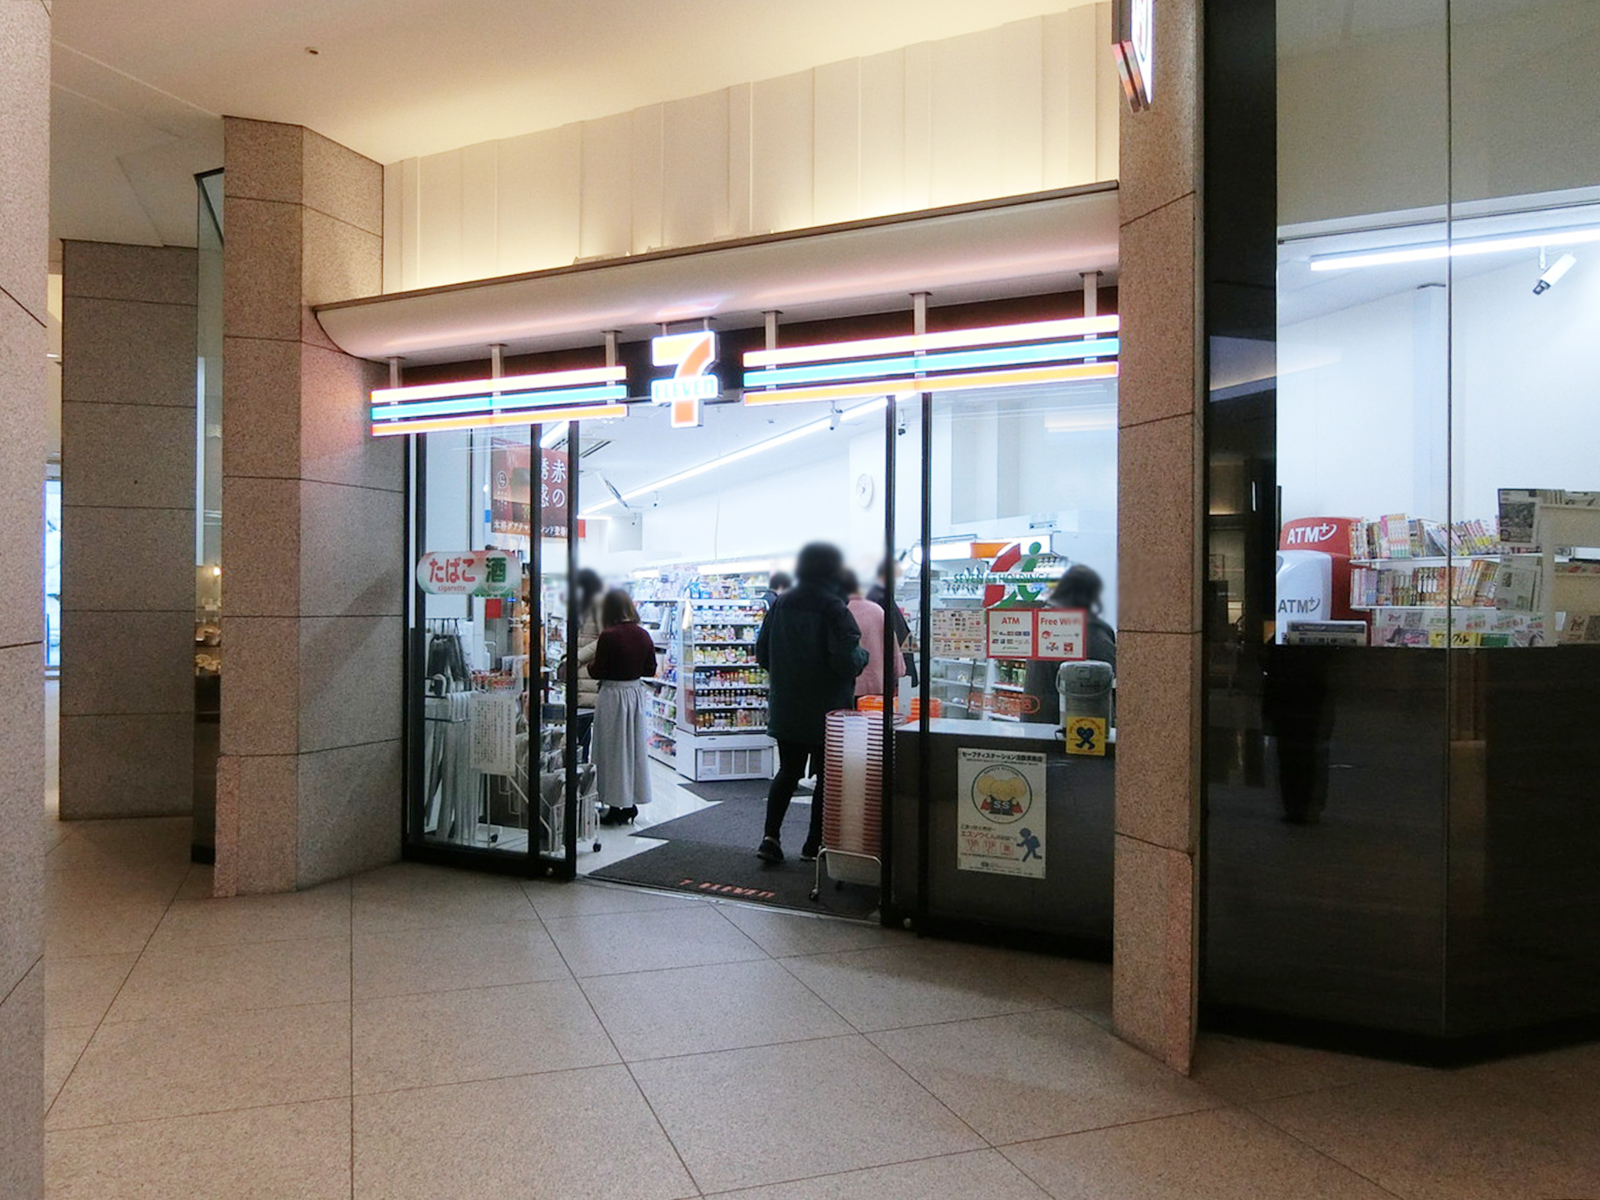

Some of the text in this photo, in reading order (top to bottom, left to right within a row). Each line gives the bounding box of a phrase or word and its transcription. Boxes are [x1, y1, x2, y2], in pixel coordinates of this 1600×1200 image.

[551, 458, 567, 508] 赤の
[429, 557, 475, 583] たばこ
[485, 557, 507, 583] 酒
[953, 573, 983, 584] SEVEN
[437, 584, 467, 592] cigarette
[1001, 617, 1021, 625] ATM
[1040, 617, 1059, 626] Free
